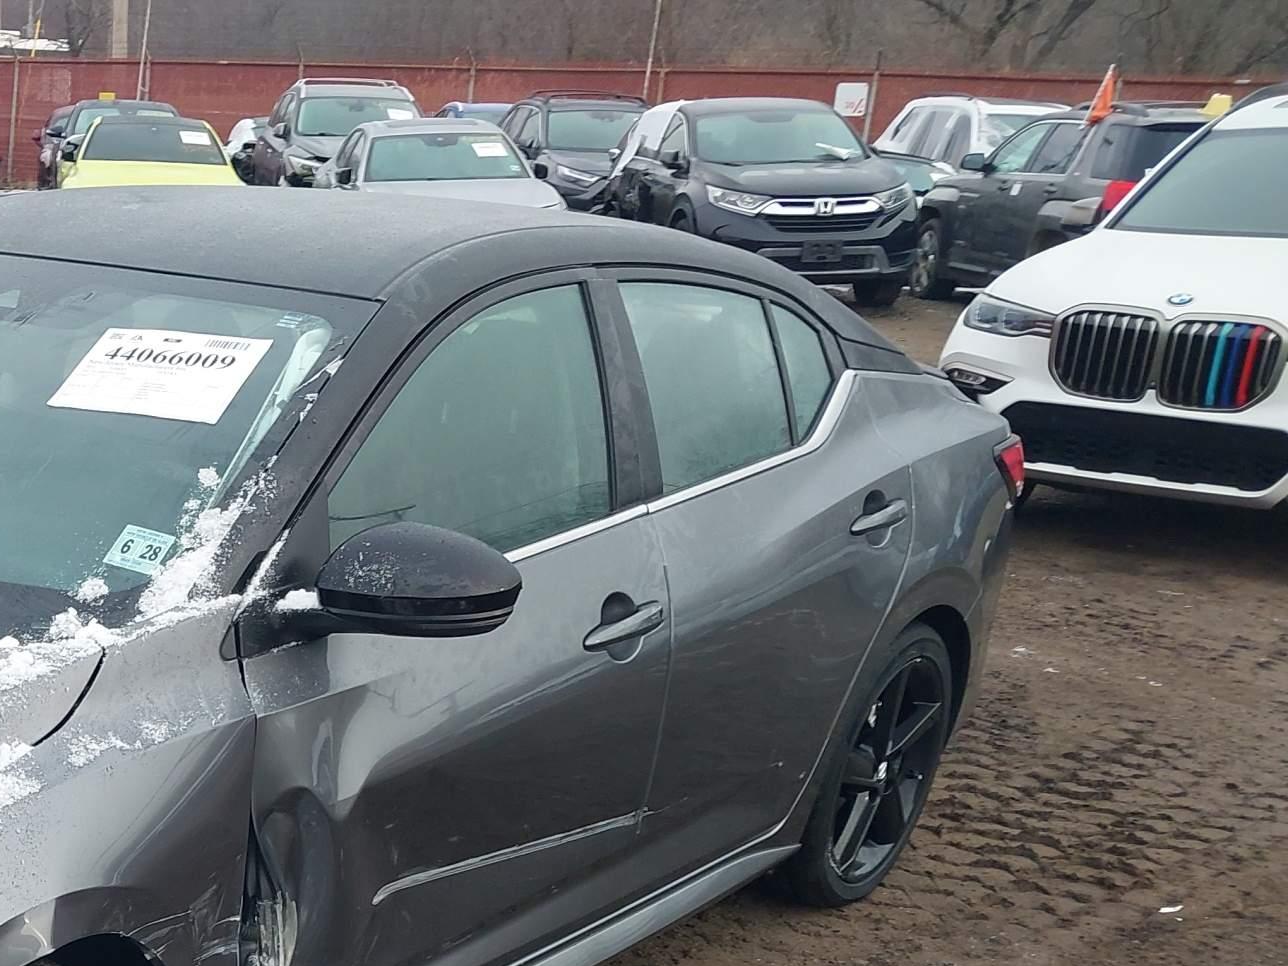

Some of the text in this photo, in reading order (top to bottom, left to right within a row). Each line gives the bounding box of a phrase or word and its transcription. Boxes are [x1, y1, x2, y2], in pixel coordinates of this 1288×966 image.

[104, 346, 237, 370] 44066009
[120, 538, 162, 561] 6 28
